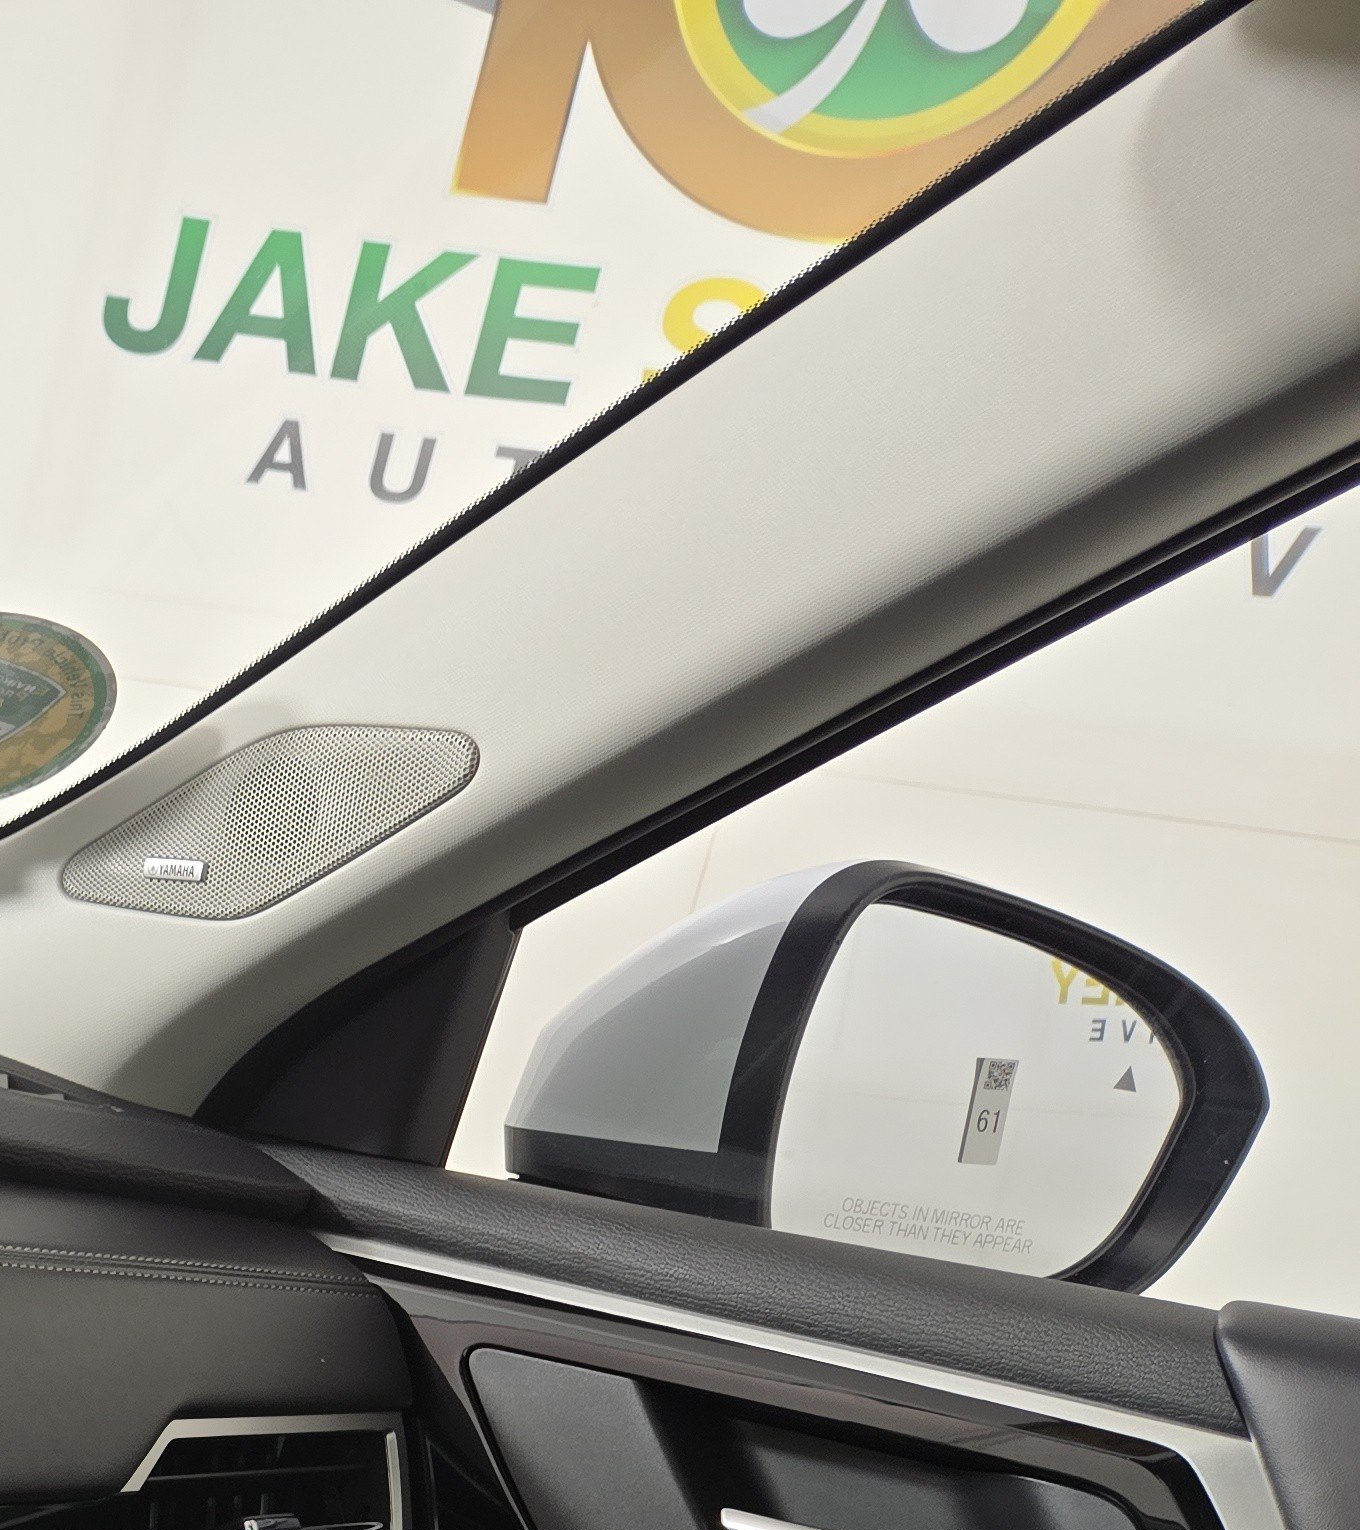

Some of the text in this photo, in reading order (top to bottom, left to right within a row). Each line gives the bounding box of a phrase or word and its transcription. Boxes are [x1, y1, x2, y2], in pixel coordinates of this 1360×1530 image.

[103, 215, 601, 407] JAKE
[159, 864, 195, 878] YAMAHA
[975, 1109, 1001, 1134] 61
[823, 1212, 1034, 1254] CLOSER THAN THEY APPEAR
[841, 1196, 1026, 1236] OBJECTS IN MIRROR ARE
